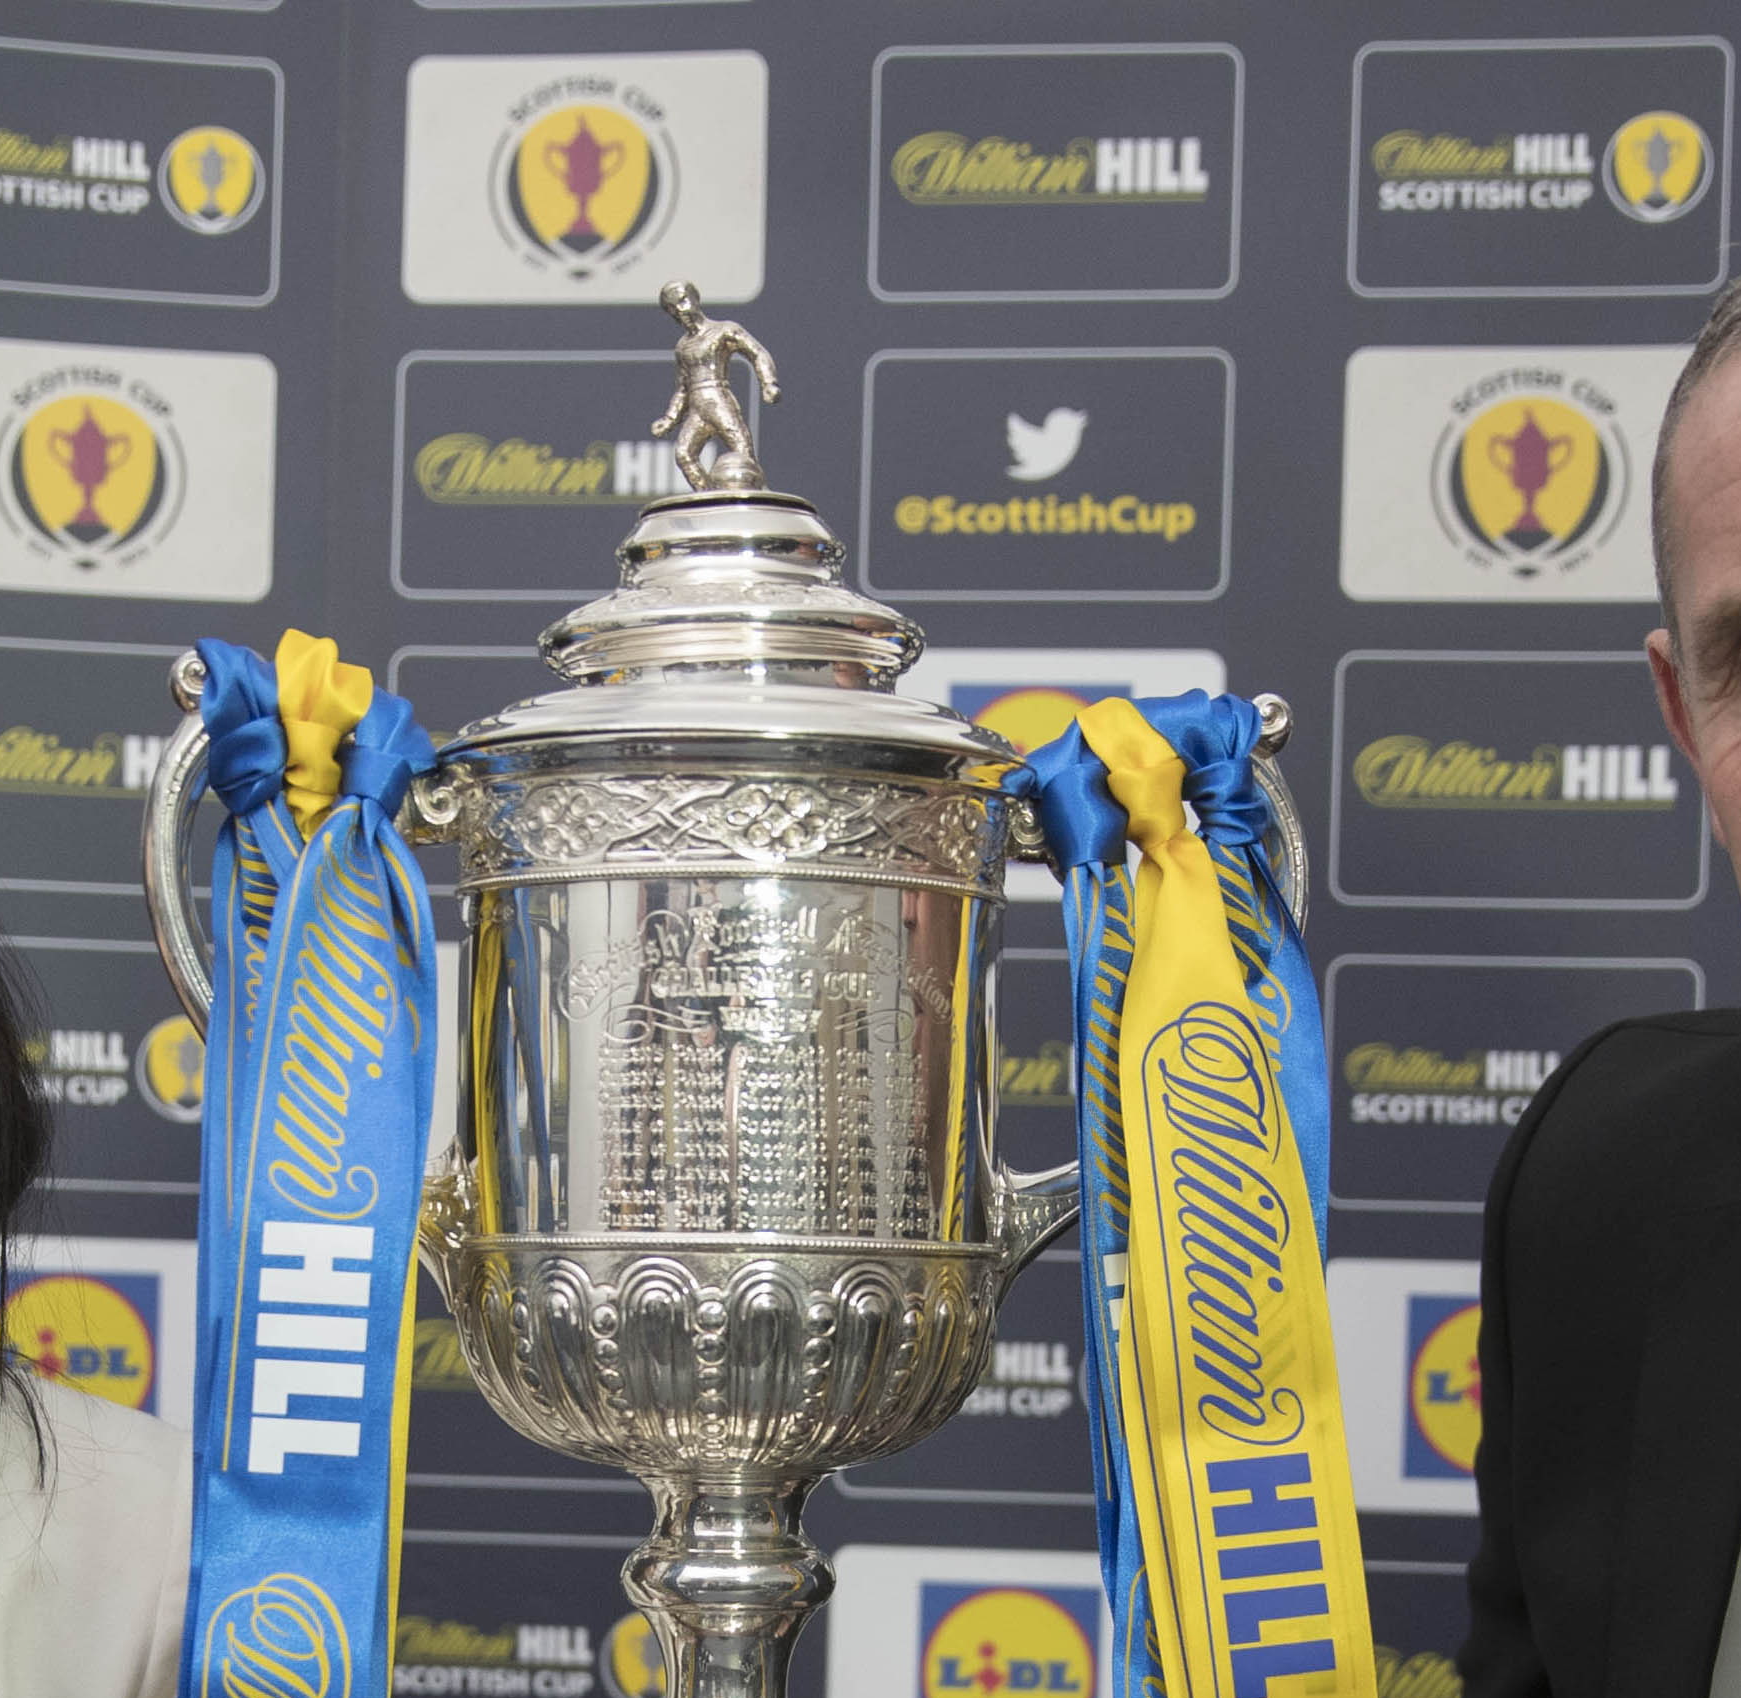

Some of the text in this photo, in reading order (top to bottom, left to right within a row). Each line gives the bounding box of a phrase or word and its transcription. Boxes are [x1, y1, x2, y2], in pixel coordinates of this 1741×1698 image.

[508, 76, 666, 122] SCOTTISH CUP
[71, 137, 151, 182] HILL
[892, 131, 1208, 200] William HILL
[1371, 130, 1593, 178] William HILL
[87, 181, 151, 215] CUP
[1378, 180, 1593, 212] SCOTTISH CUP
[12, 365, 174, 419] SCOTTISH CUP
[1450, 367, 1619, 418] SCOTTISH CUP
[415, 432, 616, 502] William
[893, 495, 1197, 543] @ScottishCup
[1353, 735, 1678, 808] William HILL
[1343, 1043, 1485, 1092] William
[1350, 1094, 1498, 1125] SCOTTISH
[1141, 1000, 1306, 1446] William
[247, 1220, 375, 1475] HILL
[994, 1342, 1071, 1382] HILL
[1011, 1388, 1071, 1418] CUP
[516, 1625, 595, 1665] HILL
[532, 1670, 595, 1698] CUP
